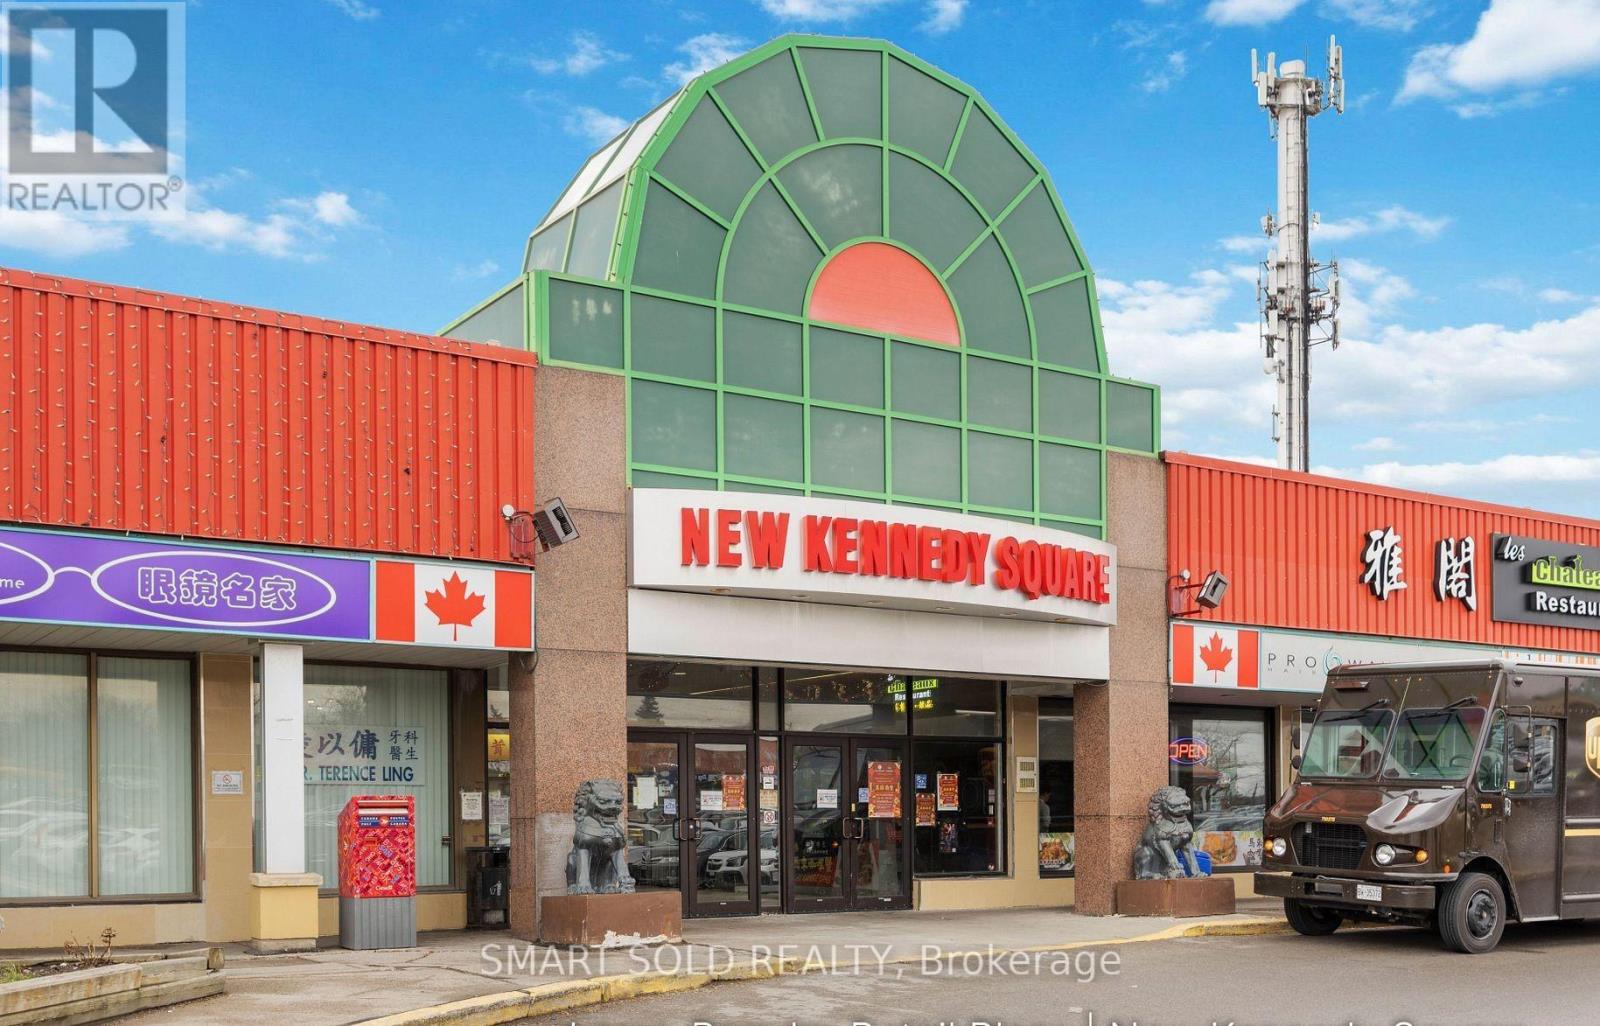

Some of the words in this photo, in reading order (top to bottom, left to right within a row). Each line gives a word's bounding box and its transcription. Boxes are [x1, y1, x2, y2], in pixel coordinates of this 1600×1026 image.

[680, 507, 790, 569] NEW
[801, 515, 991, 586] KENNEDY
[995, 536, 1110, 604] SQUARE
[1502, 536, 1525, 562] les
[138, 567, 296, 611] 眼鏡名家
[1169, 743, 1208, 758] OPEN
[319, 765, 376, 781] TERENCE
[382, 766, 414, 782] LING
